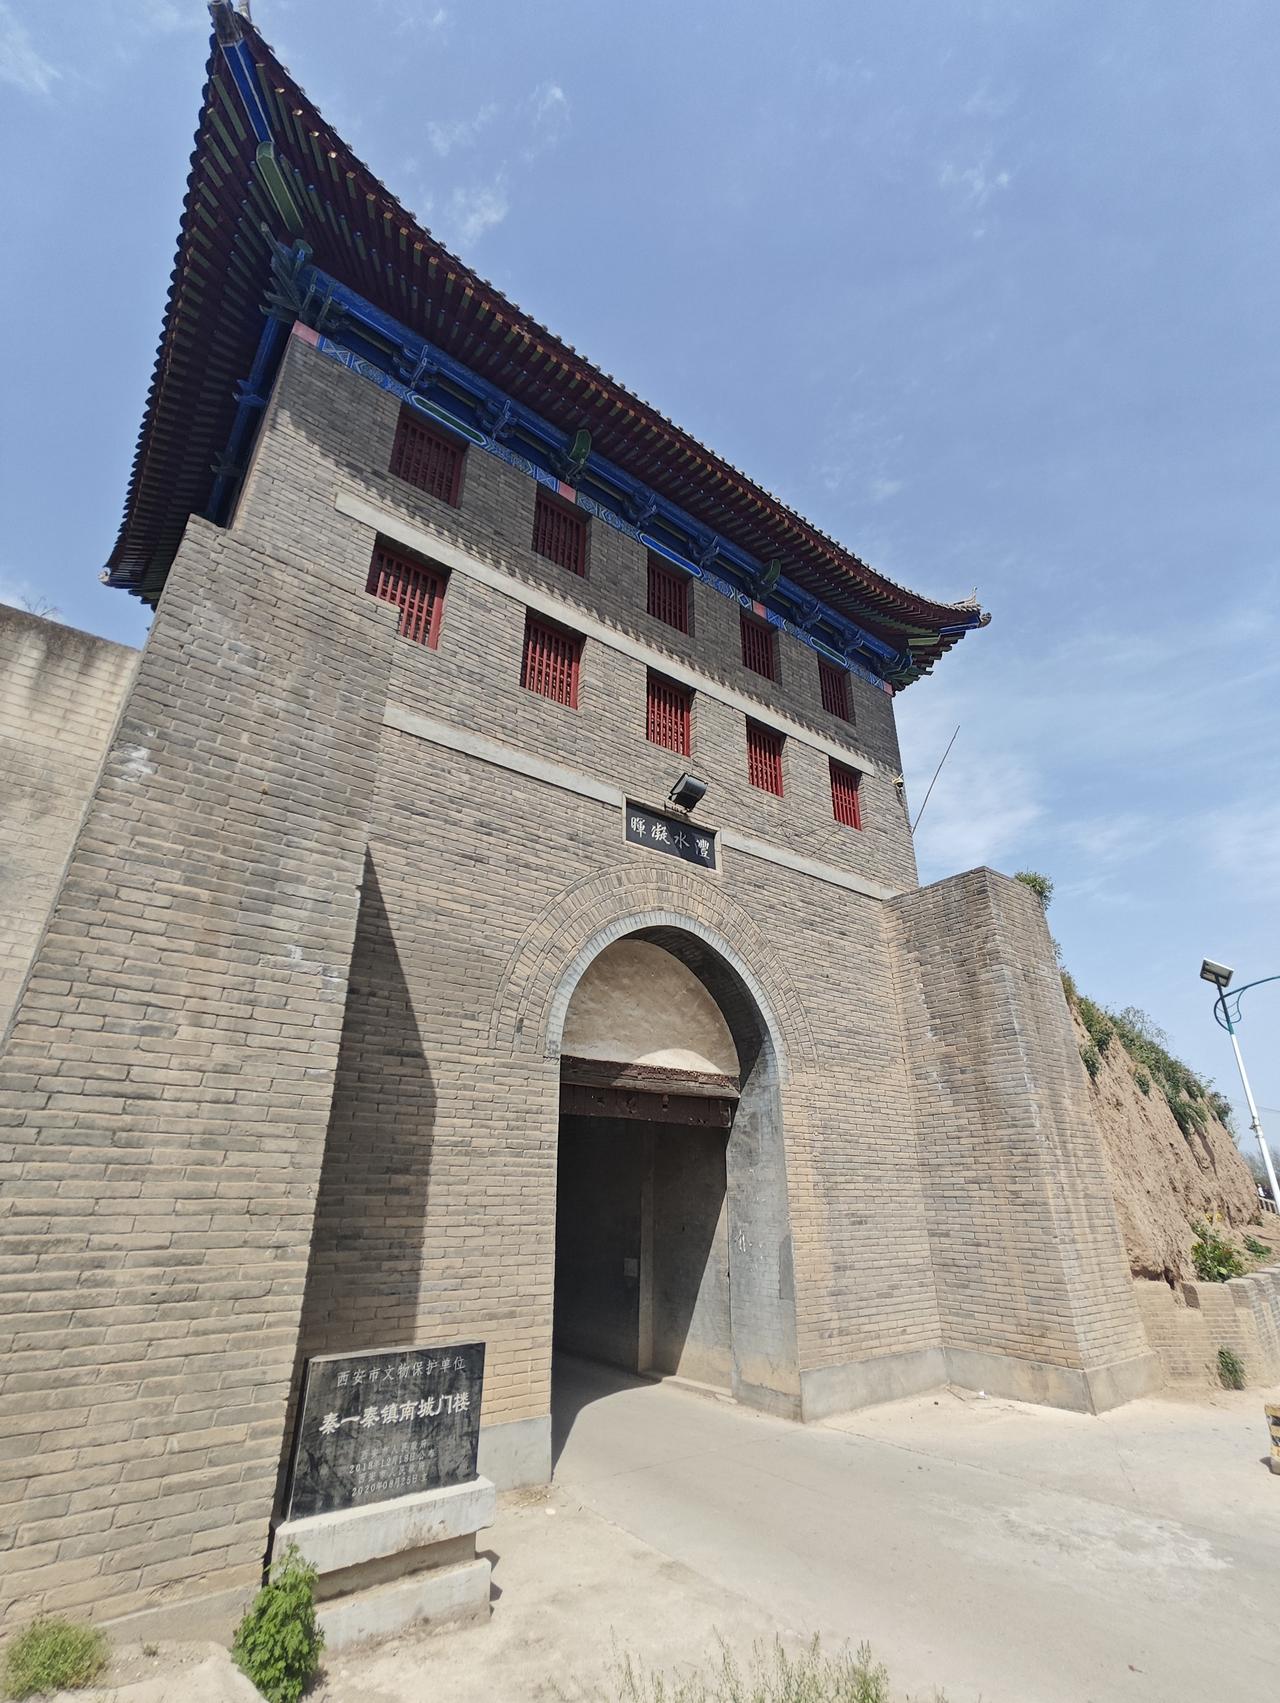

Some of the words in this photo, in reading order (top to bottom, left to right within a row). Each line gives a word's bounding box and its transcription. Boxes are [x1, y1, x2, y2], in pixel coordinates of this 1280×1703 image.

[336, 1356, 466, 1387] 西安市文物保护单位
